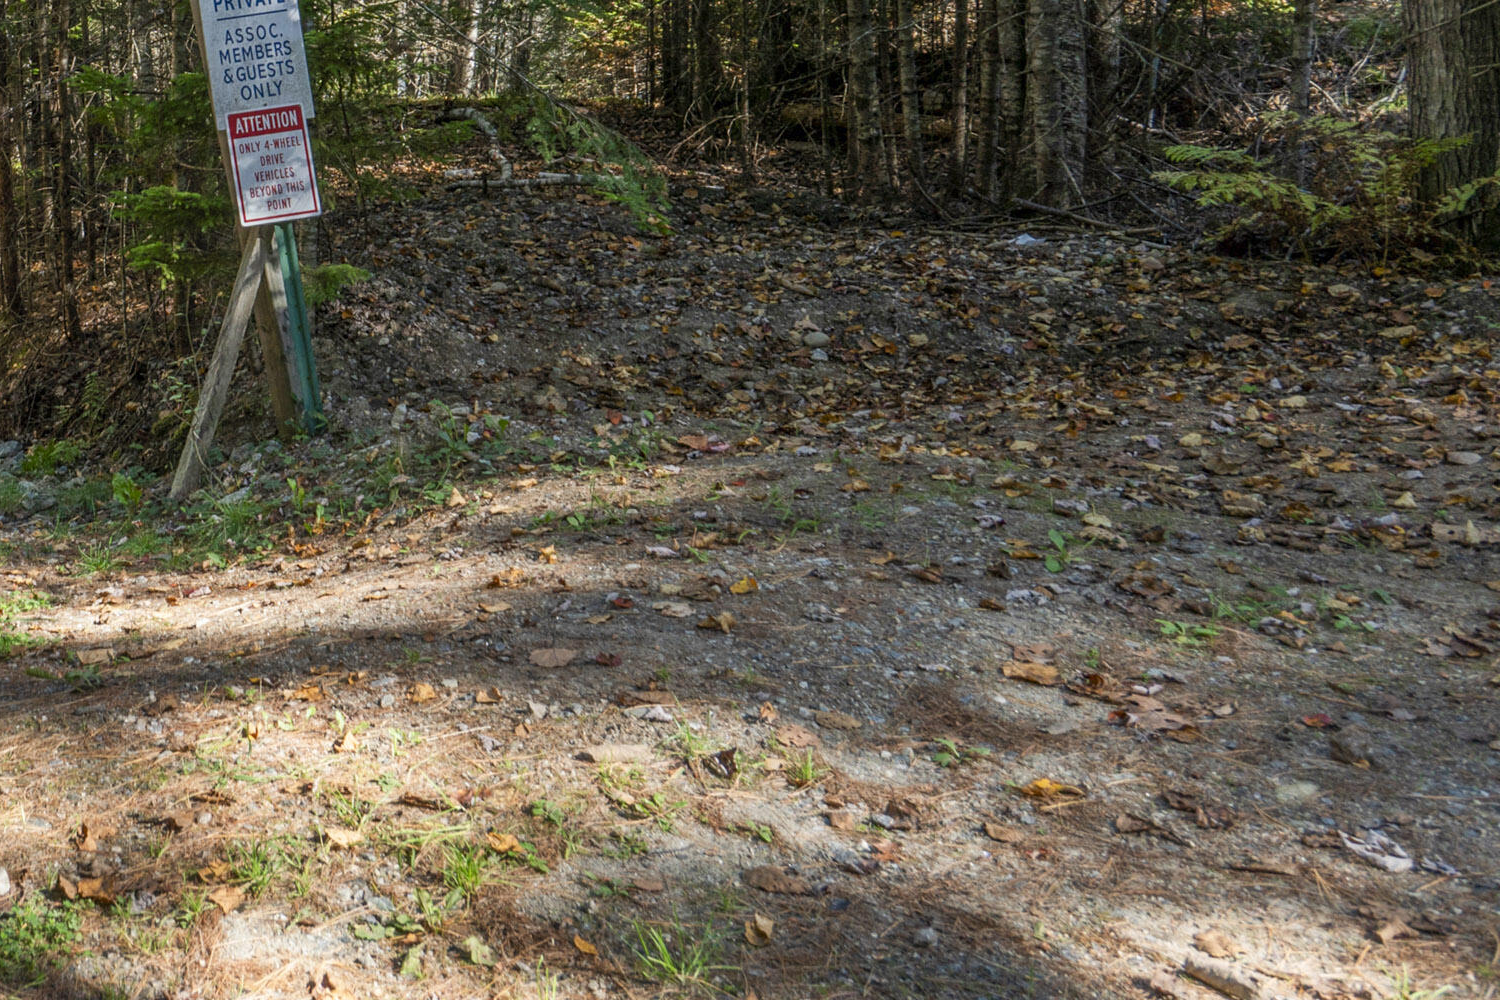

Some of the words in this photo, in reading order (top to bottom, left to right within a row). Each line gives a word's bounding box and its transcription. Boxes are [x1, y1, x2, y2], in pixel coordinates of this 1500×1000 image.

[225, 23, 283, 45] ASSOC.
[219, 40, 292, 65] MEMBERS
[240, 80, 283, 101] ONLY
[235, 109, 298, 135] ATTENTION
[239, 140, 261, 154] ONLY
[264, 135, 301, 150] 4-WHEEL
[260, 153, 285, 167] DRIVE
[254, 167, 295, 182] VEHICLES
[249, 184, 284, 198] BEYOND
[285, 181, 305, 193] THIS
[267, 197, 292, 211] POINT
